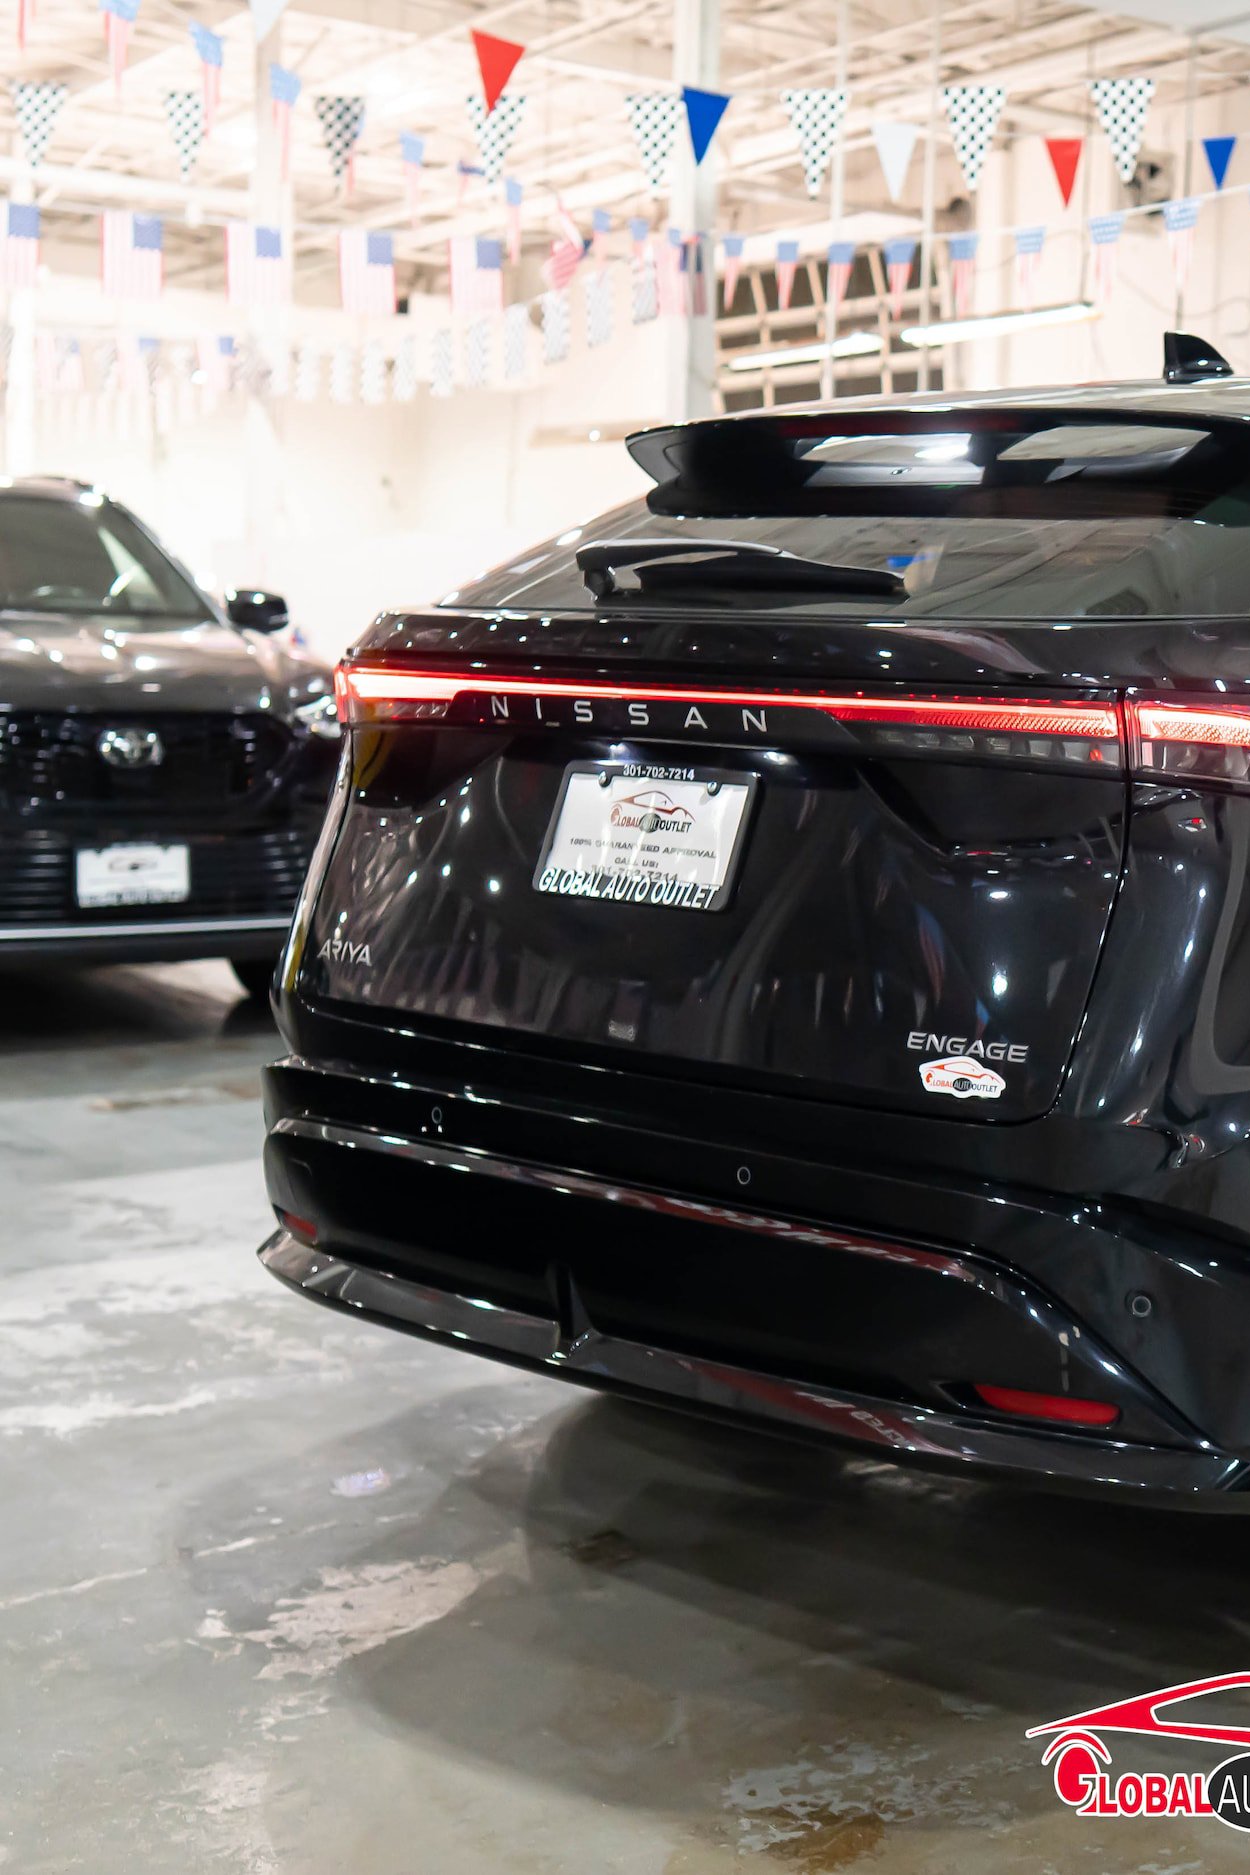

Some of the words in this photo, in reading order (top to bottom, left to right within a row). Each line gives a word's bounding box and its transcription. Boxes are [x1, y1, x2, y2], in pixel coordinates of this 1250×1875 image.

[490, 695, 768, 733] NISSAN
[622, 764, 695, 781] 301-702-7214
[595, 840, 660, 853] GUARANEED
[538, 868, 601, 899] GLOBAL
[601, 874, 650, 903] AUTO
[650, 880, 720, 910] OUTLET
[316, 938, 373, 967] ARIYA
[906, 1031, 1030, 1064] ENGAGE
